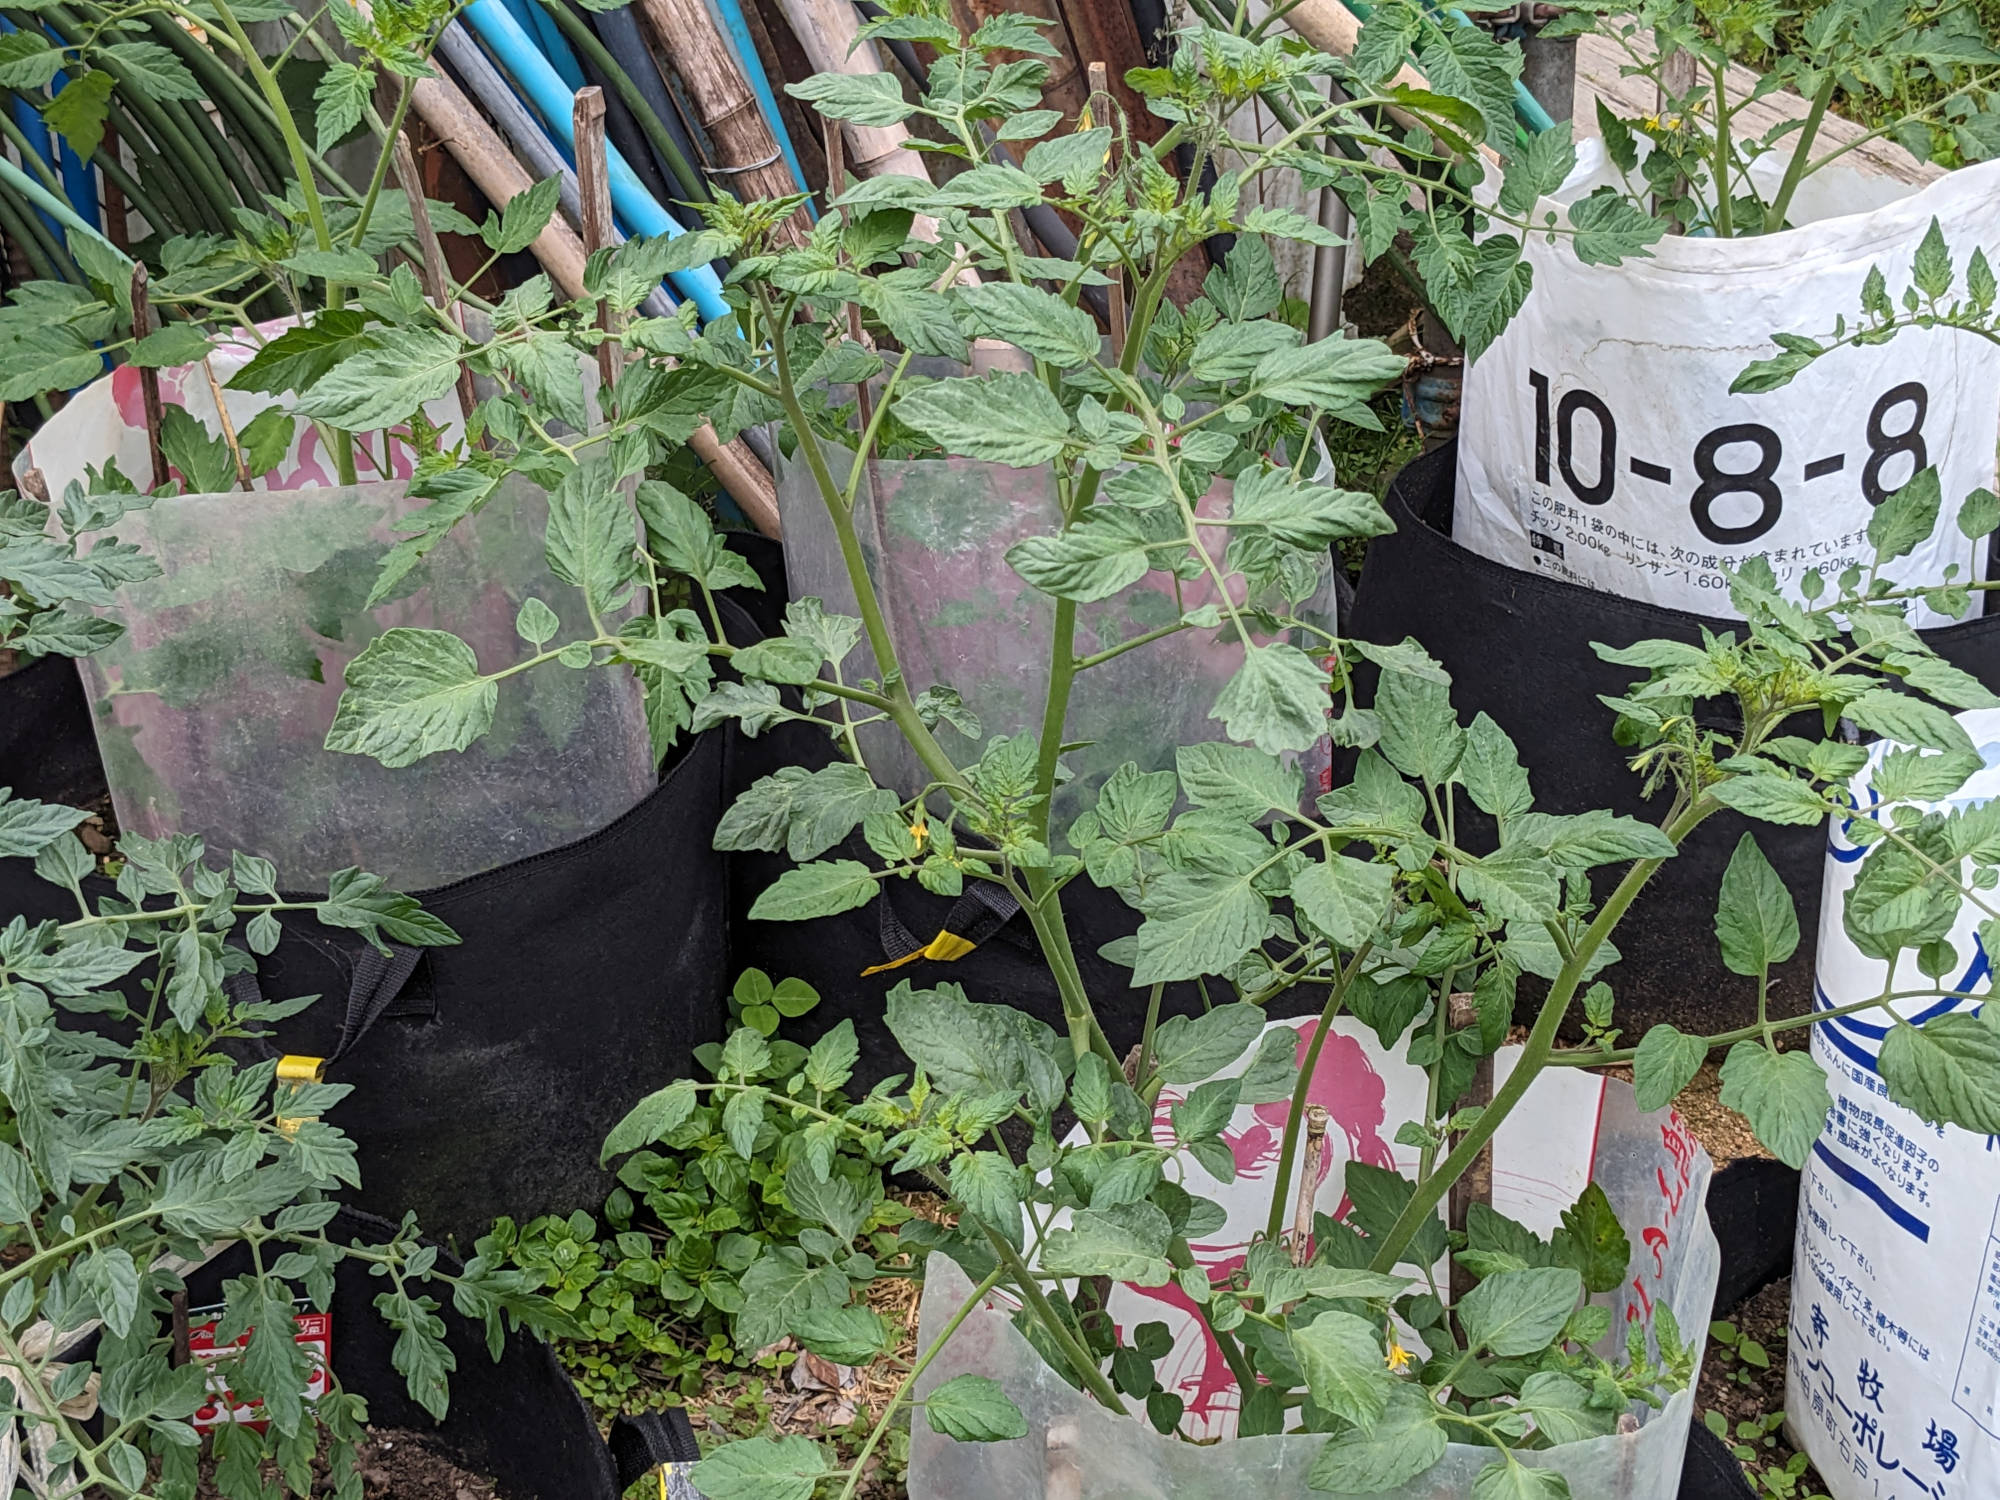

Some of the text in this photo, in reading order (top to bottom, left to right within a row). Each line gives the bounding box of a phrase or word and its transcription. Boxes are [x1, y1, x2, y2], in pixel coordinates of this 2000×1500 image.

[1529, 368, 1928, 545] 10-8-8
[1530, 510, 1561, 532] チッソ
[1565, 525, 1611, 557] 2.00kg
[1684, 571, 1731, 590] 1.60k
[1838, 1094, 1939, 1173] 植物成長促進因子の
[1857, 1358, 1884, 1414] 牧
[1922, 1418, 1960, 1474] 場
